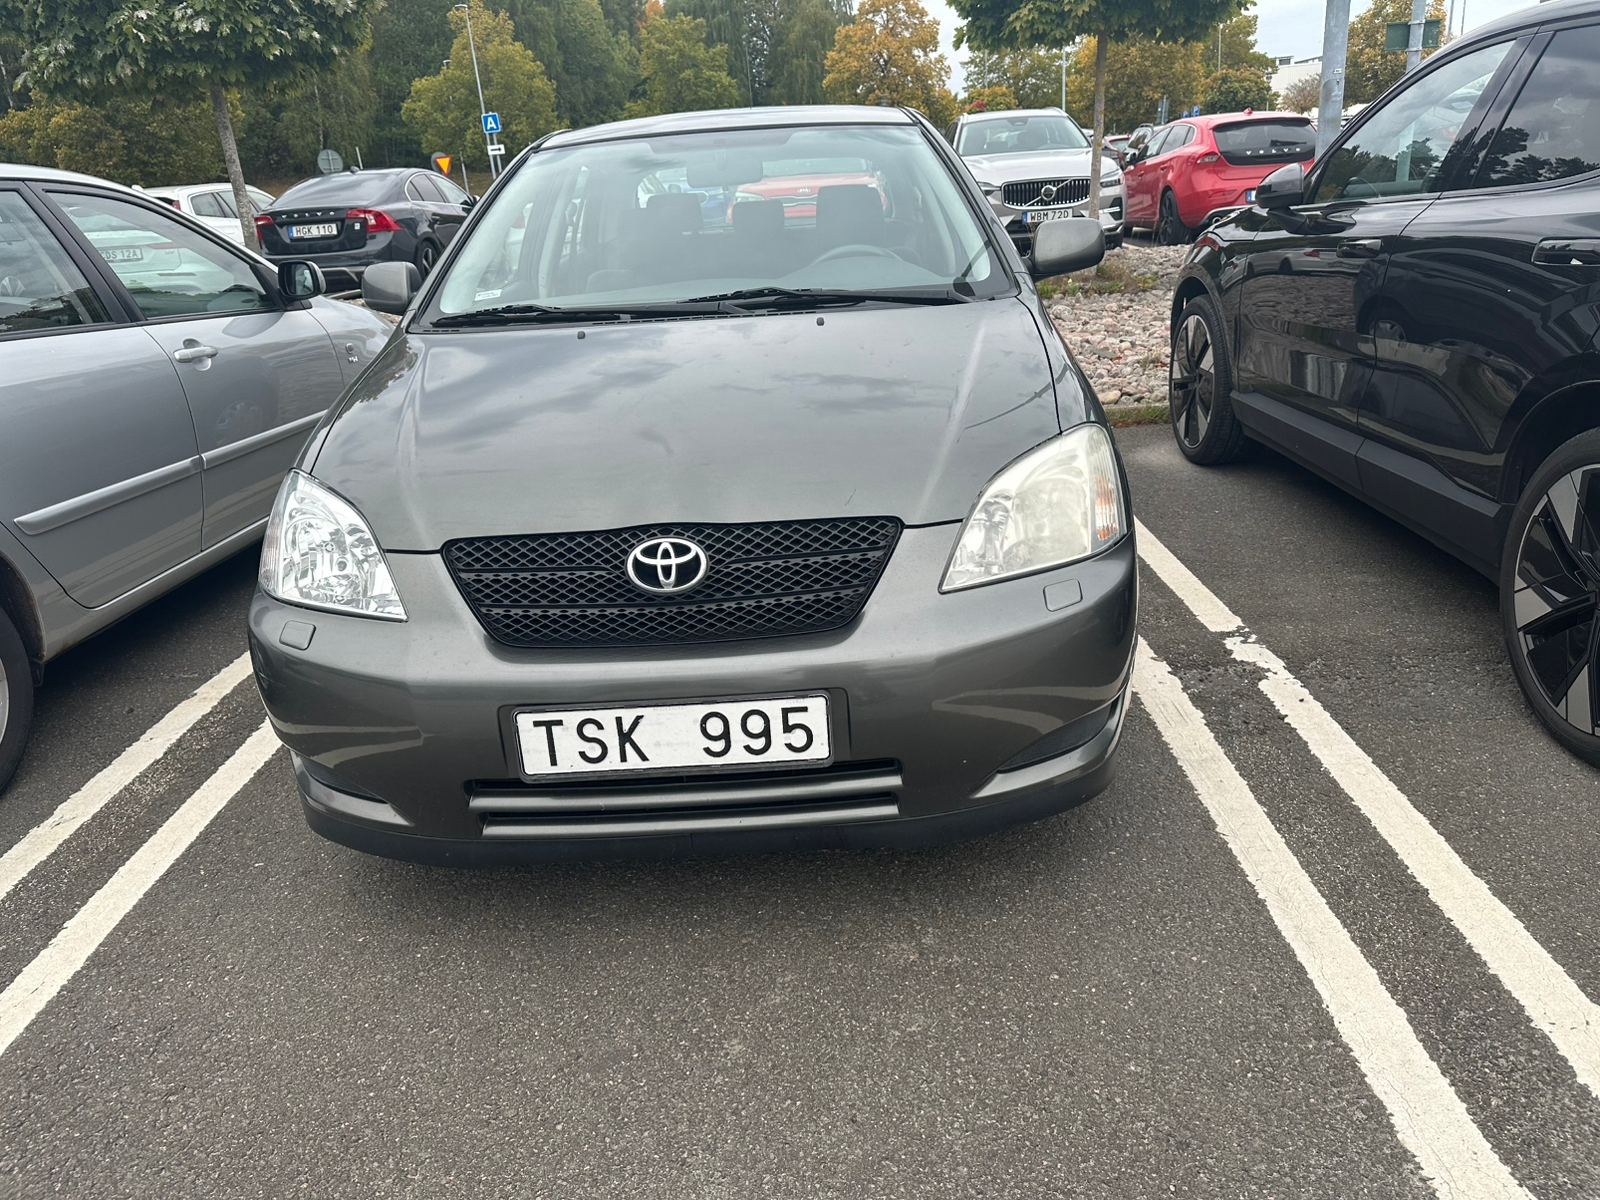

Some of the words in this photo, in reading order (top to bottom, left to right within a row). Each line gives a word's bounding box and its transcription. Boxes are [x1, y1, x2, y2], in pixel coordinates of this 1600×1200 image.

[487, 117, 497, 130] A
[1246, 147, 1301, 156] VOLVO
[281, 211, 335, 219] VOLVO
[1030, 211, 1049, 221] WBM
[1051, 210, 1069, 220] 72D
[295, 226, 313, 236] HGK
[316, 224, 333, 234] 110
[121, 249, 138, 259] 12A
[532, 715, 650, 767] TSK
[700, 706, 814, 758] 995
